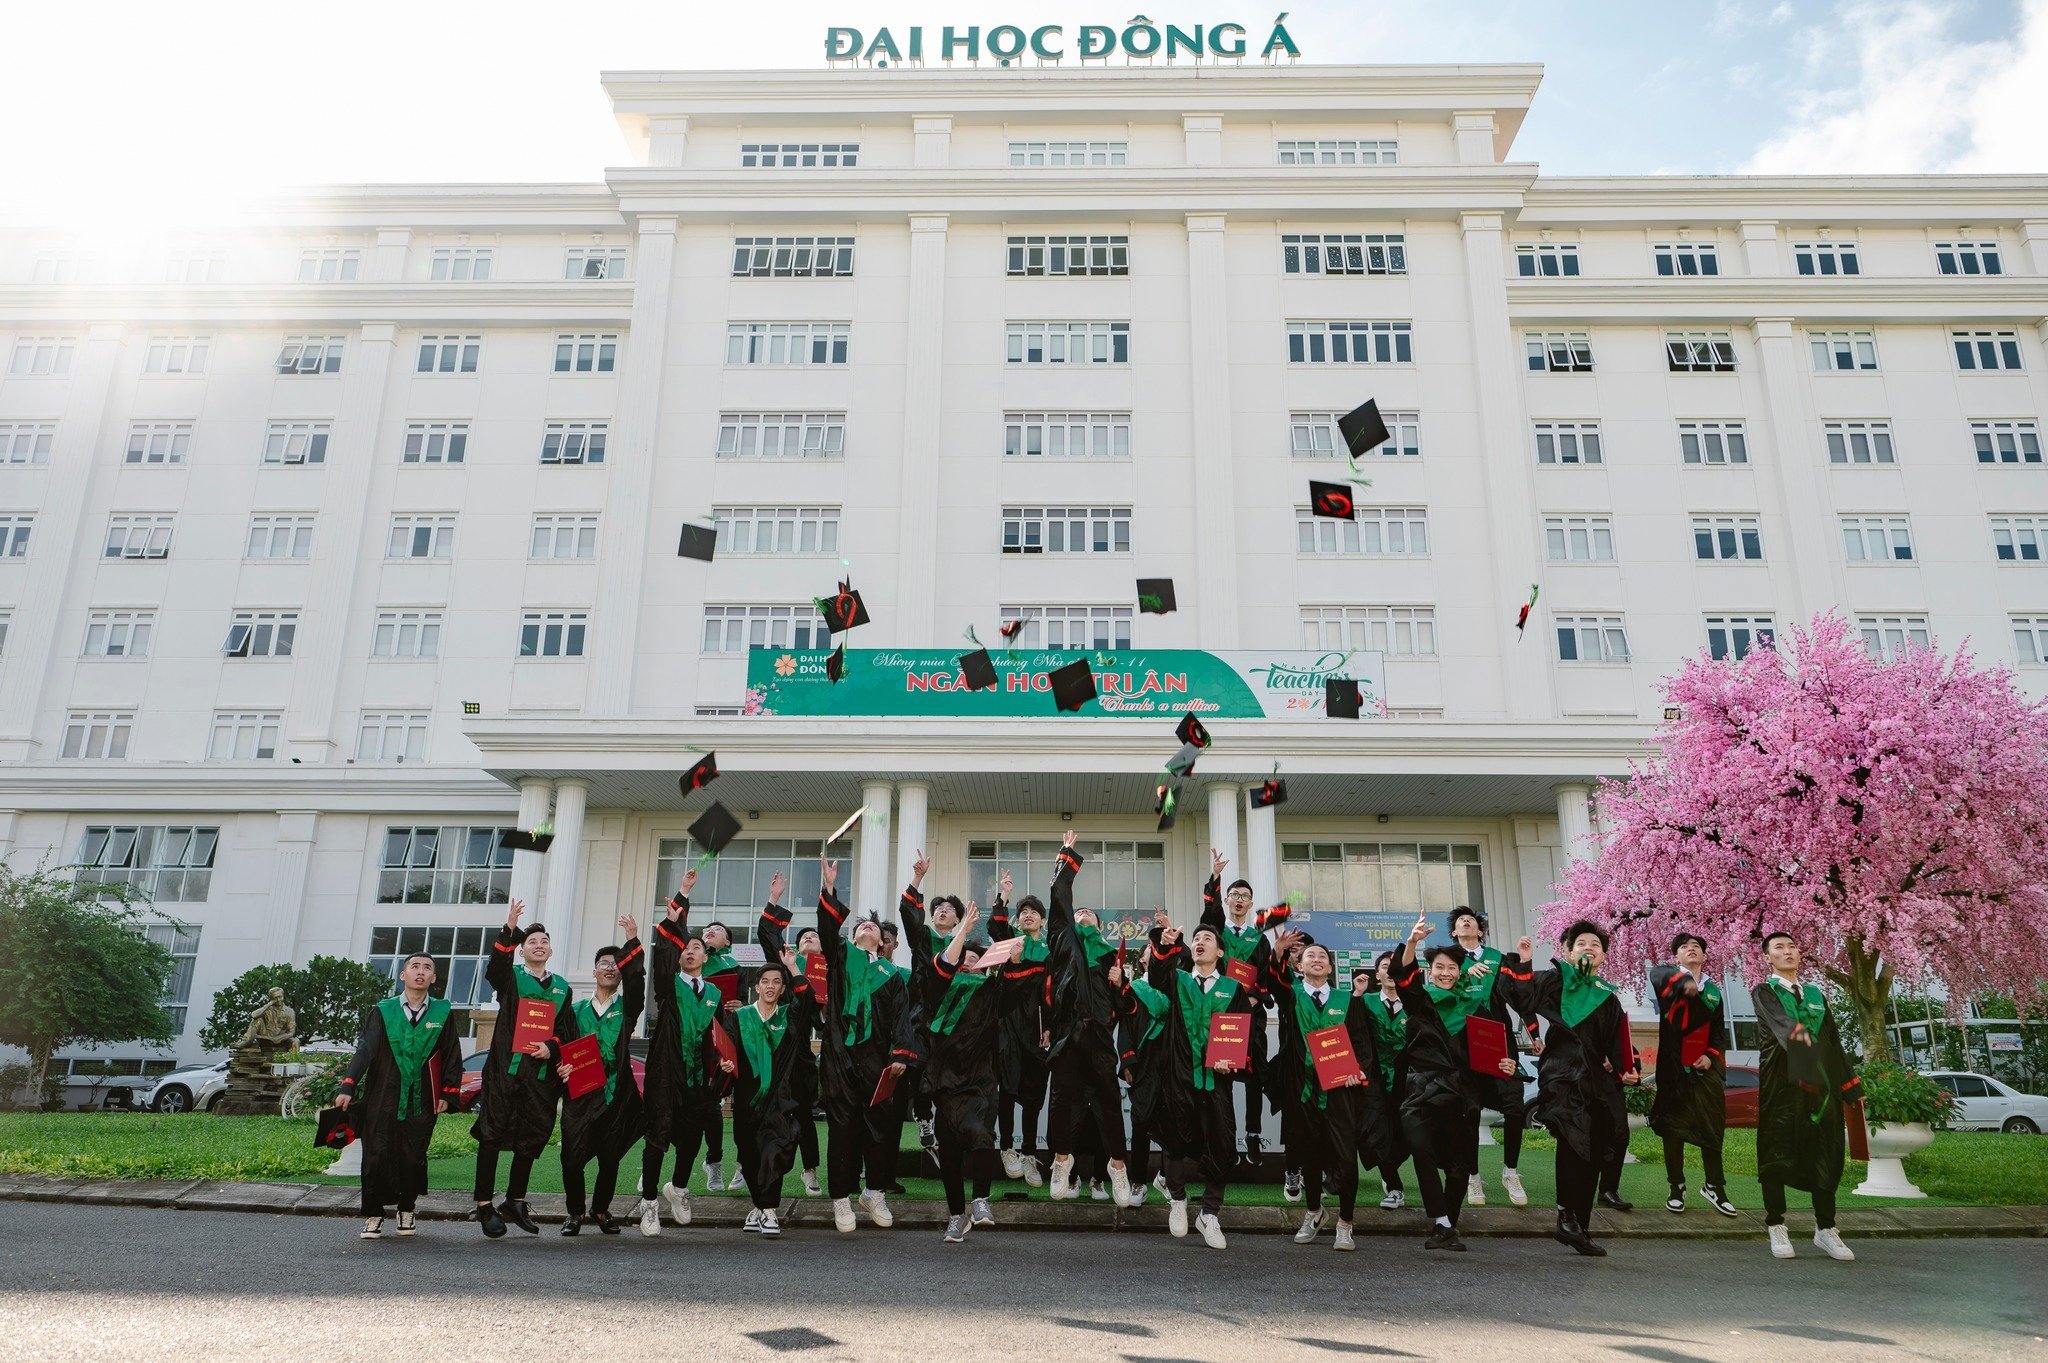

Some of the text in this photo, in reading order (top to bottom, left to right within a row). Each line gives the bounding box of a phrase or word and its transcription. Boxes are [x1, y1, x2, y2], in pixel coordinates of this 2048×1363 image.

[825, 12, 1301, 68] ĐẠI HỌC ĐÔNG Á
[799, 663, 828, 674] ĐÔN
[800, 655, 818, 664] ĐẠI
[872, 652, 916, 671] Mừng
[920, 657, 945, 666] mùa
[1033, 652, 1064, 667] Nhà
[1281, 662, 1326, 672] HAPPY
[1006, 671, 1054, 693] HO
[1143, 669, 1188, 693] ÂN
[1099, 694, 1221, 712] Thanks a million
[1106, 920, 1149, 941] 202
[1366, 929, 1403, 940] TOPIK
